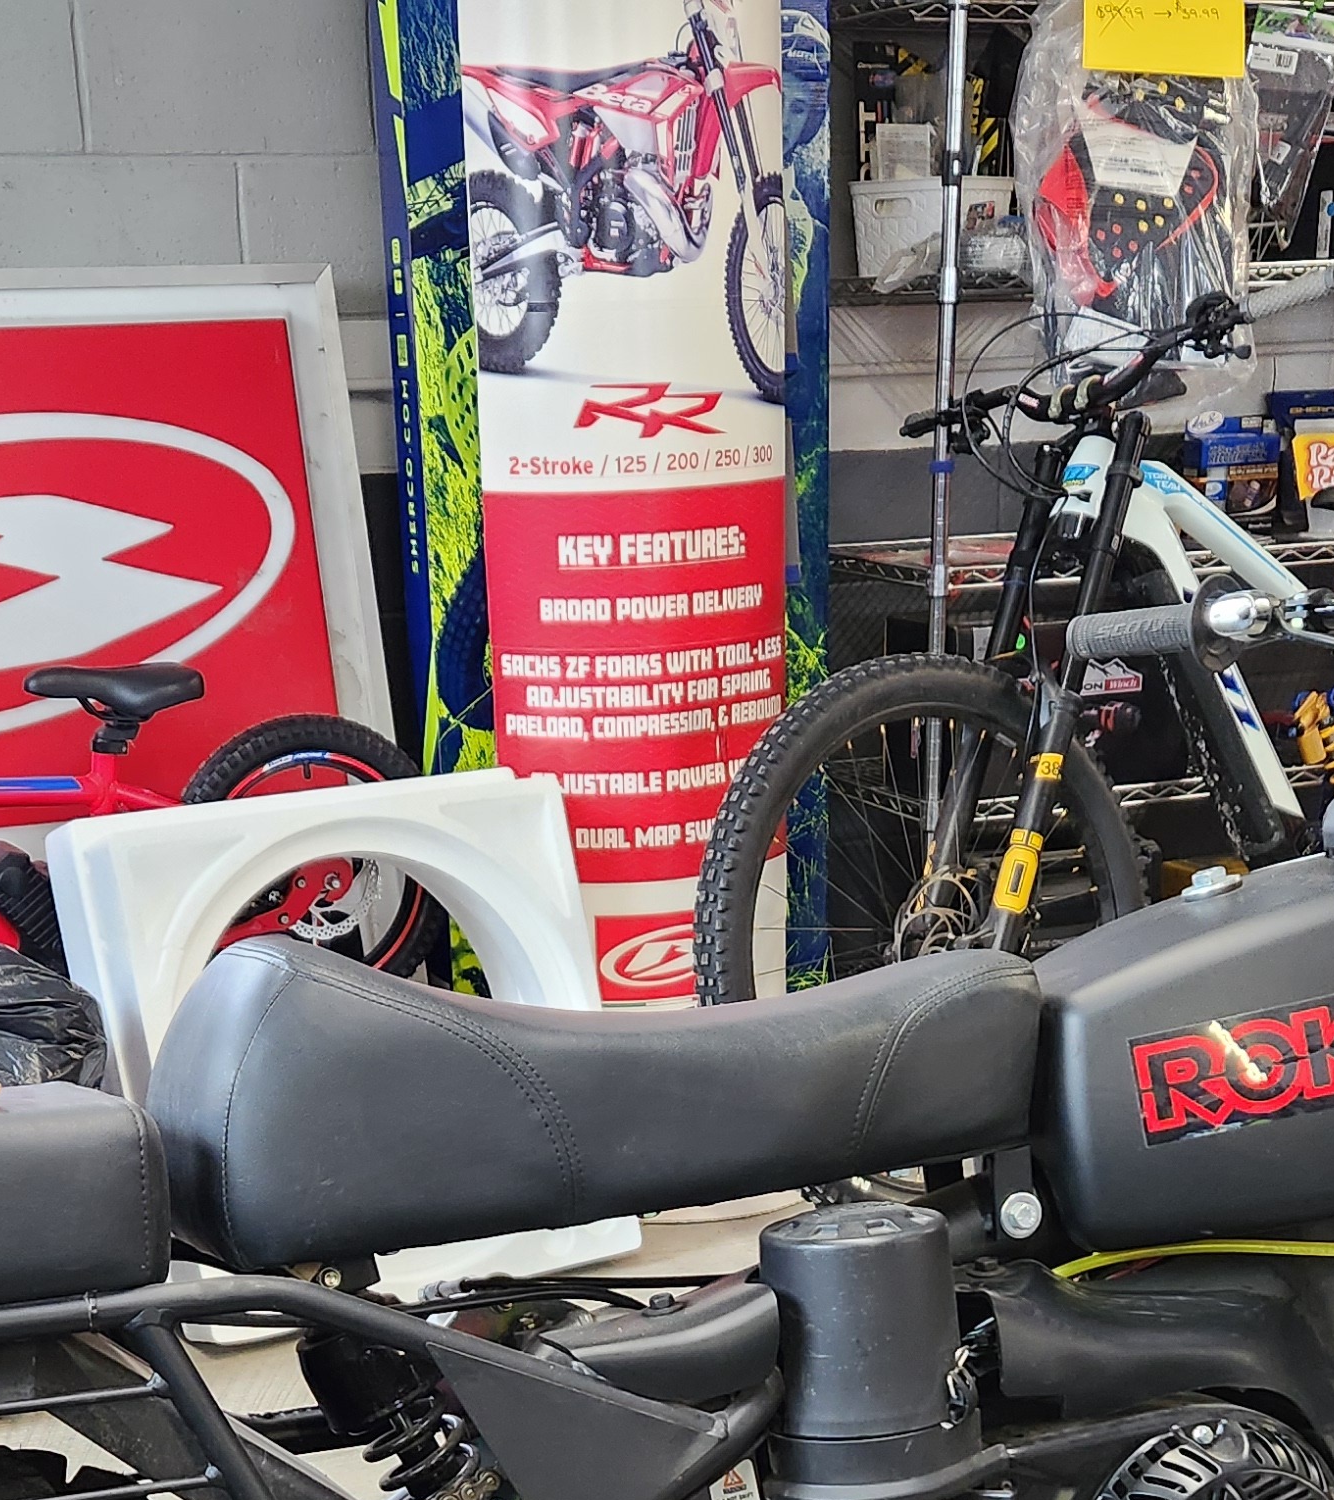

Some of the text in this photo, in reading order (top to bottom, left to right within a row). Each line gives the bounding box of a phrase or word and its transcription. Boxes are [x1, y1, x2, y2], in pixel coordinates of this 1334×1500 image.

[578, 83, 652, 114] Beta
[508, 455, 594, 475] 2-Stroke
[614, 455, 647, 473] 125
[666, 452, 699, 470] 200
[715, 448, 741, 467] 250
[752, 444, 773, 464] 300
[1154, 479, 1182, 492] TEAM
[557, 525, 746, 566] KEY FEATURES:
[539, 583, 763, 622] BROAD POWER DELIVERY
[500, 635, 783, 678] SACHS ZF FORKS WITH TOOL-LESS
[526, 668, 771, 708] ADJUSTABILITY FOR SPRING
[1107, 676, 1139, 691] Winch
[505, 694, 782, 742] PRELOAD, COMPRESSION, & REBOUND
[531, 770, 662, 795] JUSTABLE
[666, 761, 725, 792] POWER
[1040, 759, 1062, 777] 38
[575, 827, 631, 849] DUAL
[634, 824, 681, 848] MAP
